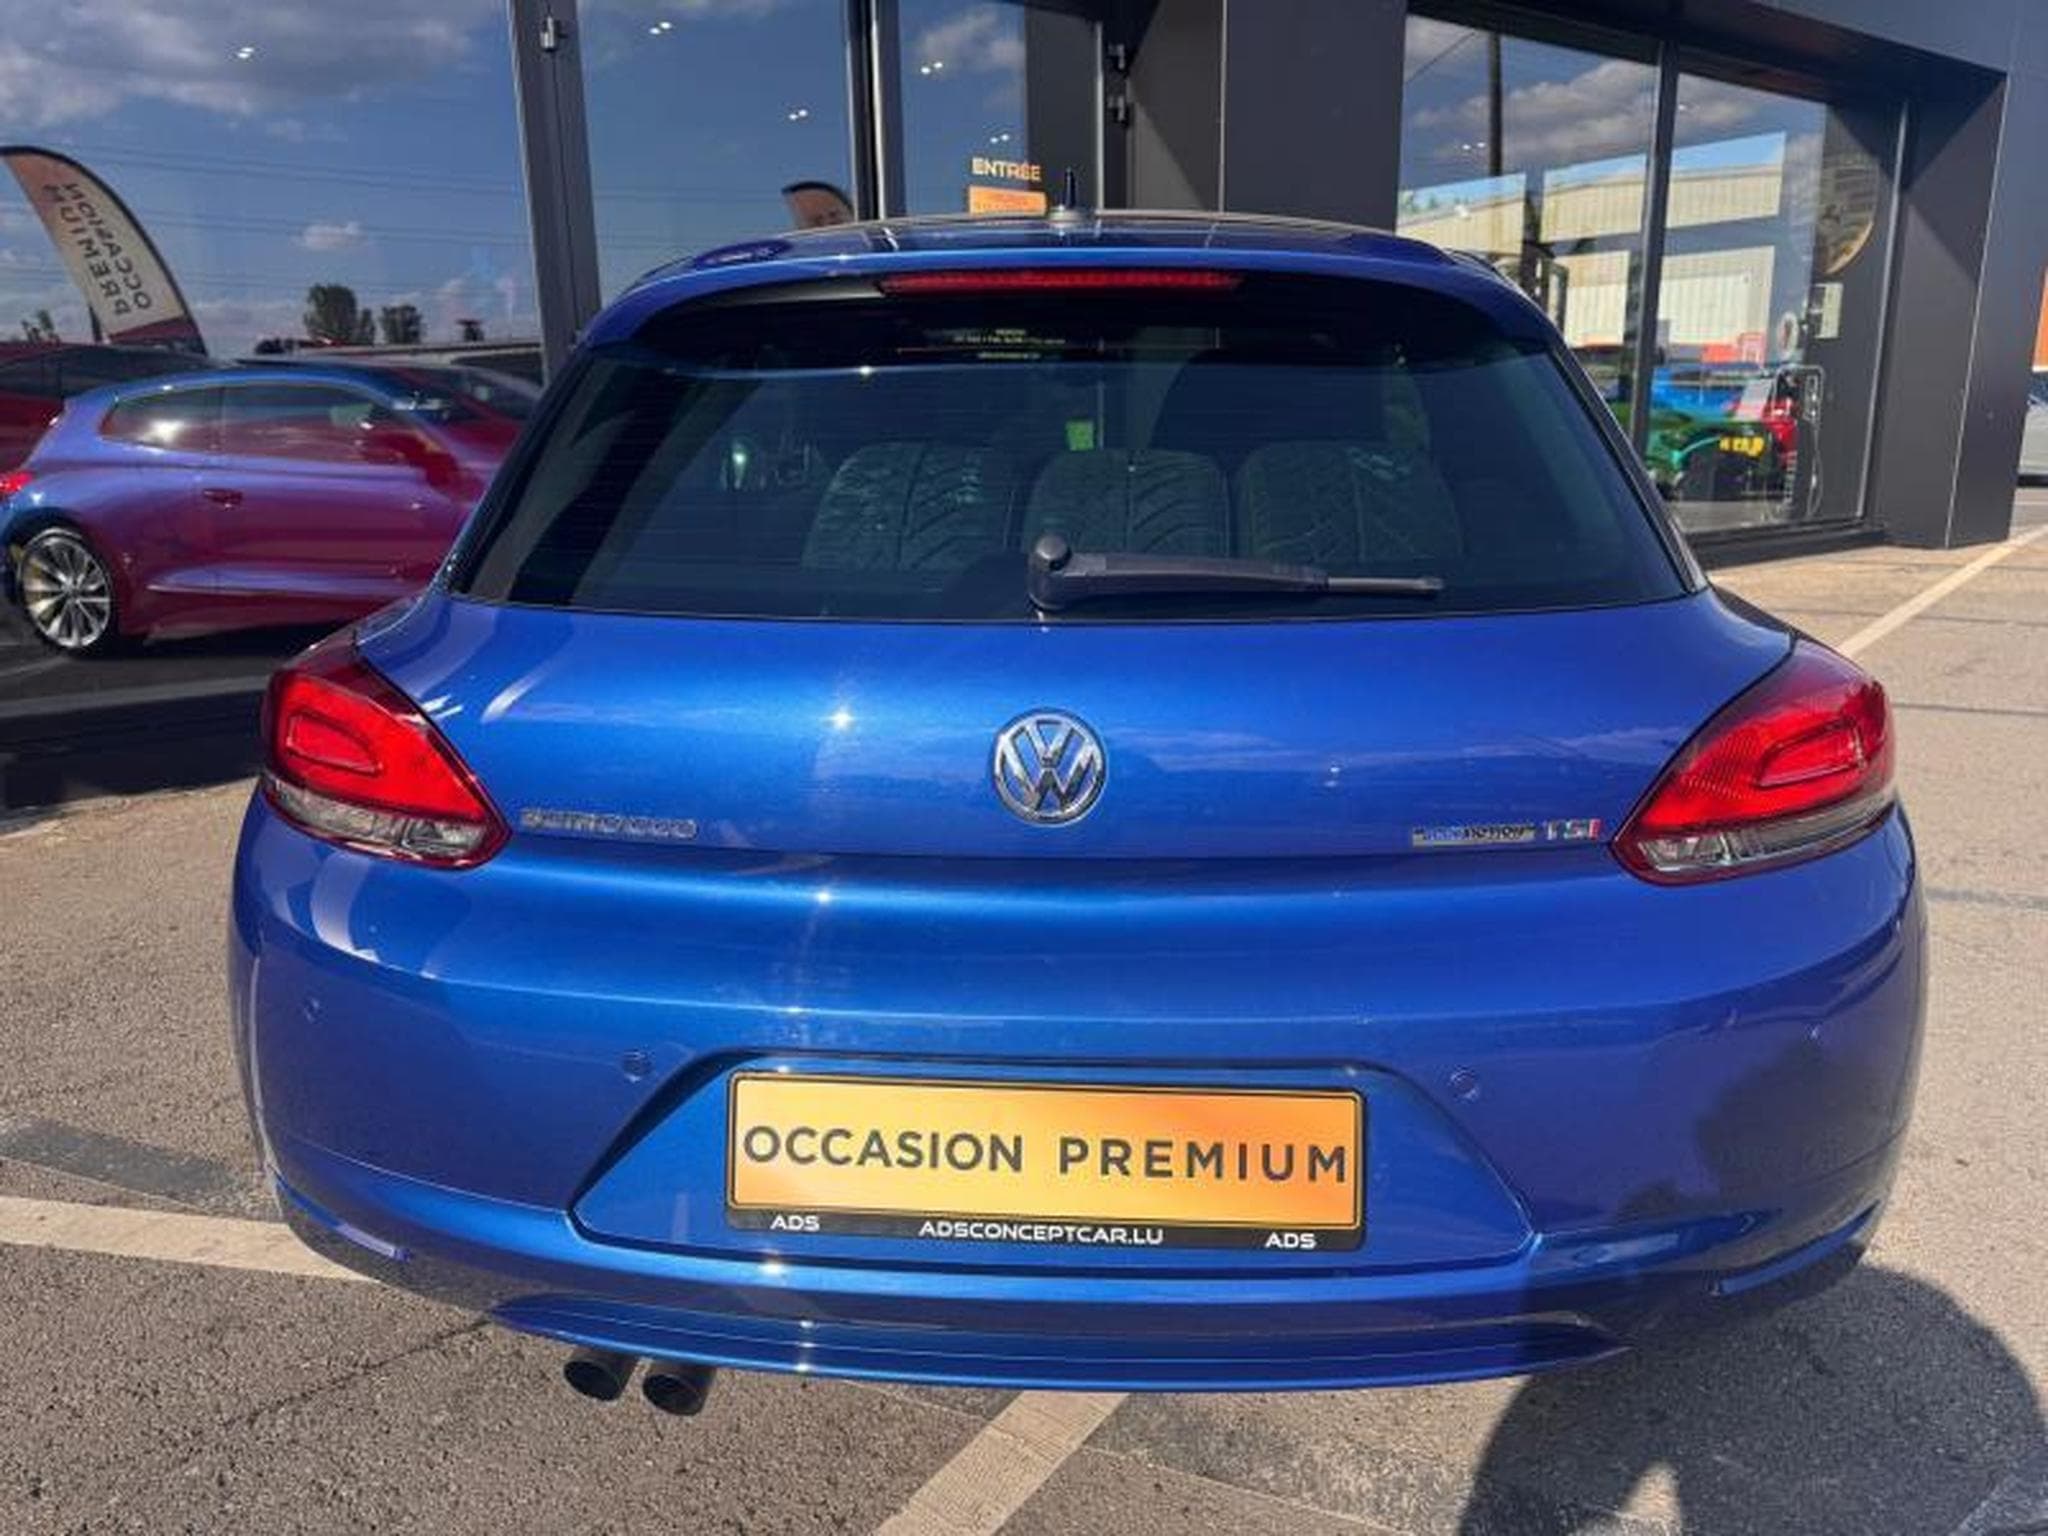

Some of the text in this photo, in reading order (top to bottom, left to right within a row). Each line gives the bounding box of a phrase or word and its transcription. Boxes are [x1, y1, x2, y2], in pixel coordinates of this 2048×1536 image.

[743, 1125, 1347, 1183] OCCASION PREMIUM
[769, 1214, 821, 1232] ADS
[918, 1220, 1164, 1245] ADSCONCEPTCAR.LU
[1264, 1231, 1318, 1249] ADS
